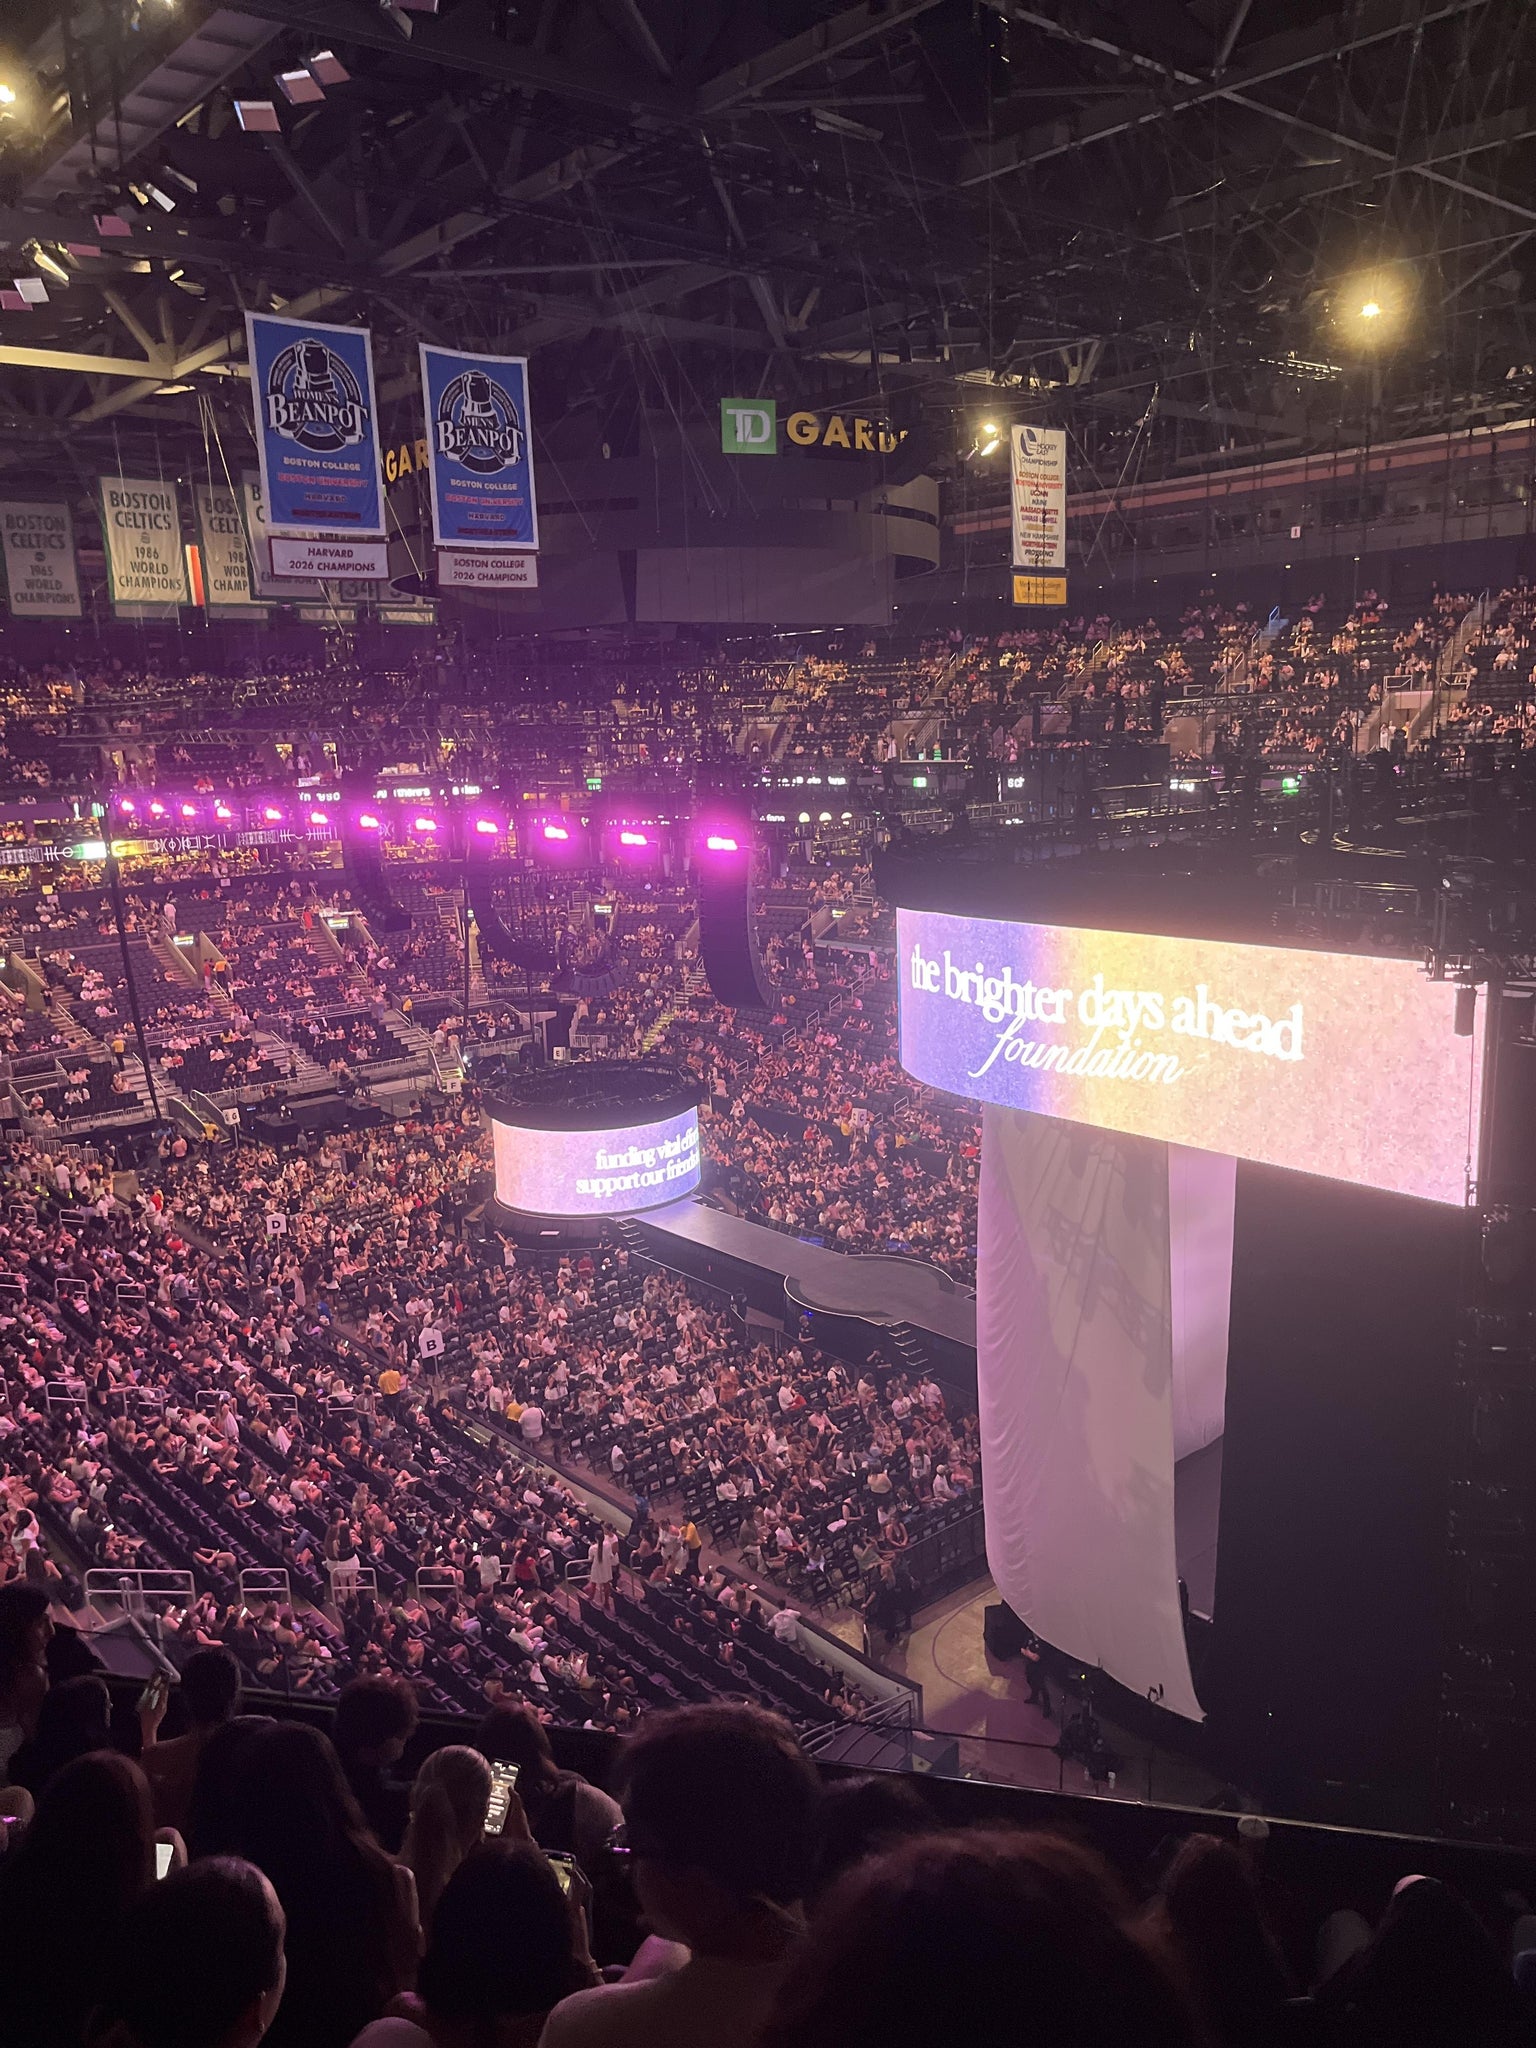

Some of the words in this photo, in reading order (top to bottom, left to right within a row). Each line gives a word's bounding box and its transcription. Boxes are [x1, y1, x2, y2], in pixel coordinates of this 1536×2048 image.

[266, 393, 368, 437] BEANPOT
[726, 408, 771, 443] TD
[436, 420, 524, 459] BEANPOT
[283, 456, 320, 469] BOSTON
[322, 460, 361, 471] COLLEGE
[386, 439, 429, 482] GAR
[450, 478, 482, 489] BOSTON
[484, 482, 518, 491] COLLEGE
[109, 489, 172, 511] BOSTON
[5, 513, 66, 532] BOSTON
[114, 511, 172, 531] CELTICS
[11, 532, 66, 550] CELTICS
[135, 546, 160, 560] 1986
[228, 551, 246, 564] 198
[307, 547, 354, 559] HARVARD
[29, 564, 54, 577] 1965
[129, 560, 169, 576] WORLD
[288, 560, 314, 571] 2026
[317, 562, 376, 572] CHAMPIONS
[453, 558, 489, 569] BOSTON
[490, 560, 525, 569] COLLEGE
[223, 565, 247, 578] WOR
[453, 571, 475, 581] 2026
[477, 573, 528, 582] CHAMPIONS
[24, 578, 63, 591] WORLD
[118, 575, 182, 591] CHAMPIONS
[213, 579, 248, 591] CHAMP
[14, 592, 76, 605] CHAMPIONS
[910, 943, 940, 994] the
[944, 951, 1071, 1024] brighter
[1078, 973, 1165, 1040] days
[1172, 985, 1305, 1062] ahead
[968, 1014, 1186, 1084] foundation
[595, 1145, 656, 1168] funding
[656, 1133, 681, 1160] vital
[575, 1171, 640, 1198] support
[640, 1168, 666, 1187] our
[271, 1220, 281, 1229] D
[426, 1340, 437, 1351] B
